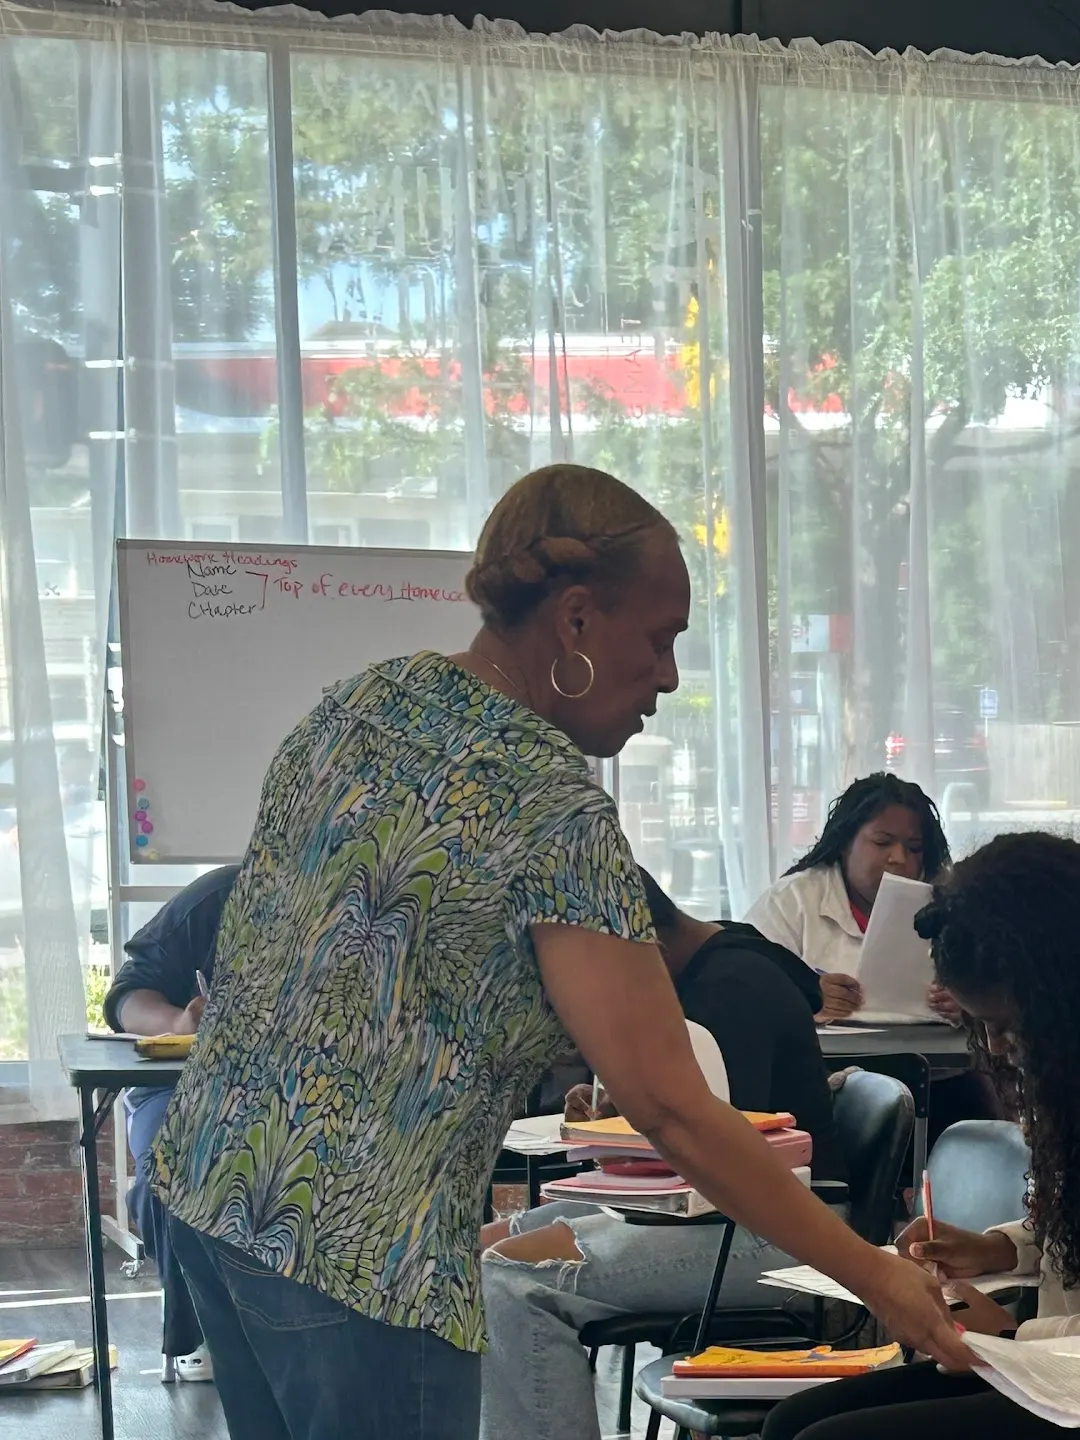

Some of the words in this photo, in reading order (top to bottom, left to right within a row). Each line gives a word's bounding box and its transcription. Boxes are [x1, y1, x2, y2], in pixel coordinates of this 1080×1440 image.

[146, 551, 218, 567] Homework
[222, 551, 298, 574] Headings
[187, 561, 237, 578] Name
[273, 577, 304, 598] Top
[312, 573, 333, 596] of
[338, 581, 393, 600] every
